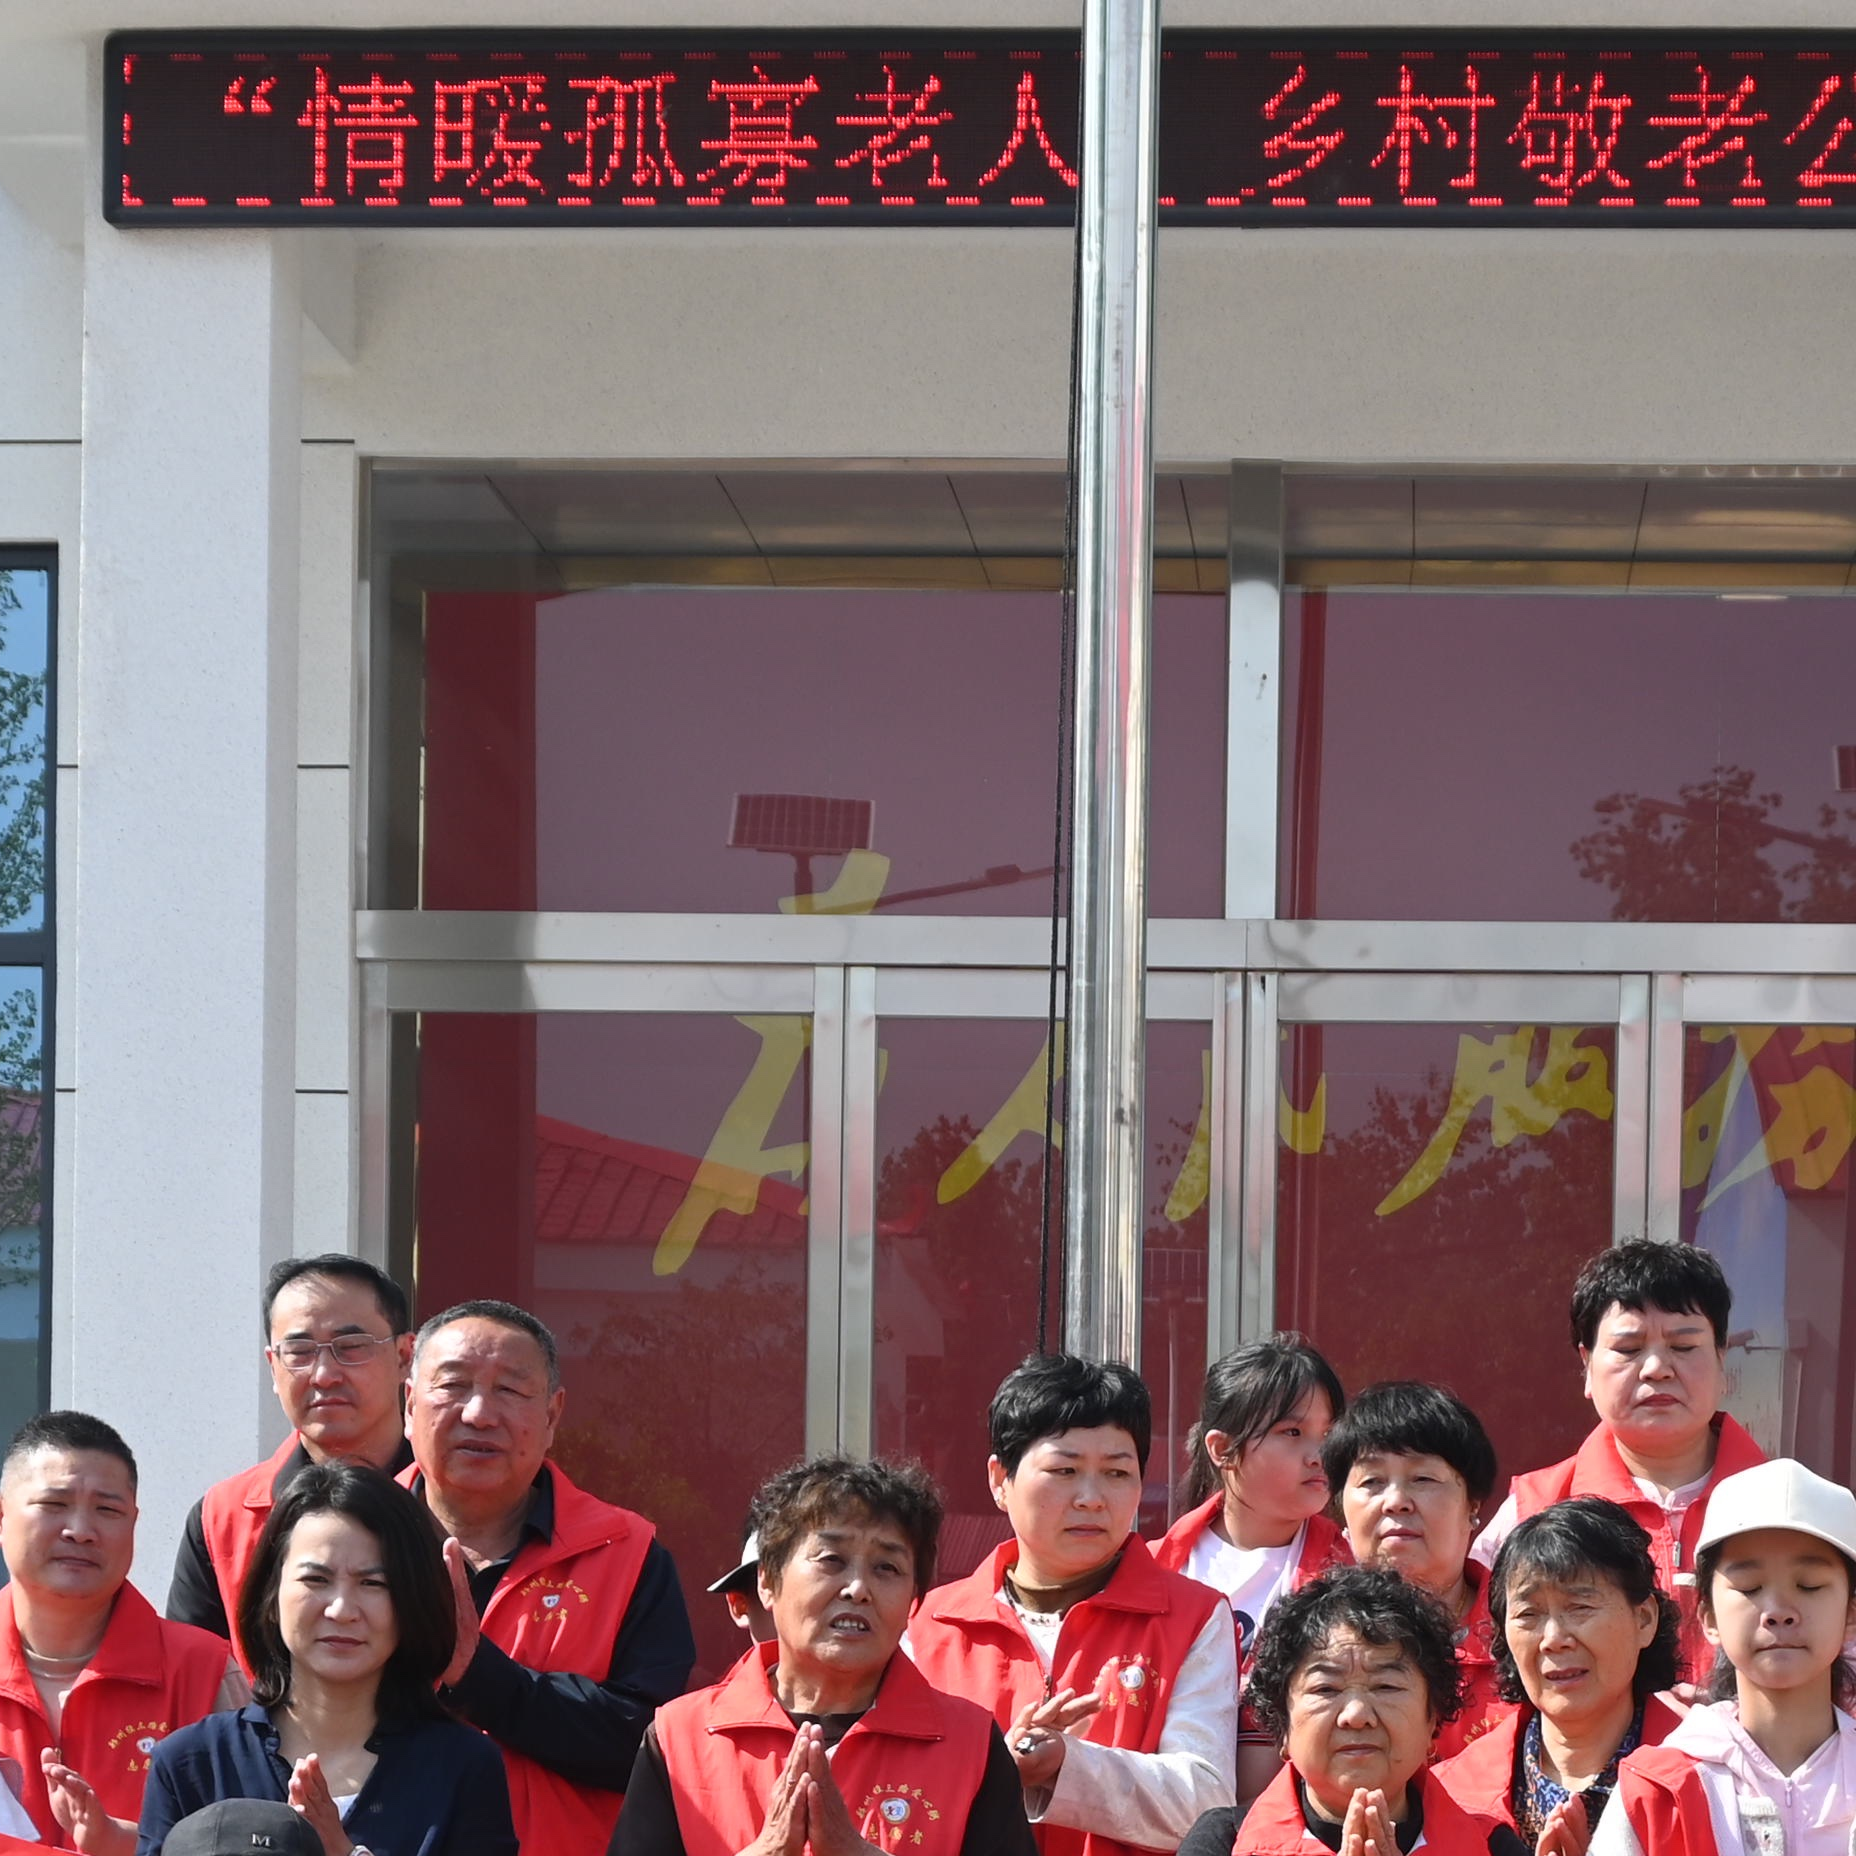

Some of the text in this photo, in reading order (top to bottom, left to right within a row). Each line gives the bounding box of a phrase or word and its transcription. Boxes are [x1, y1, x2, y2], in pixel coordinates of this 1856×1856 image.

[222, 66, 1078, 196] “情暖孤寡老人
[251, 1833, 271, 1847] M
